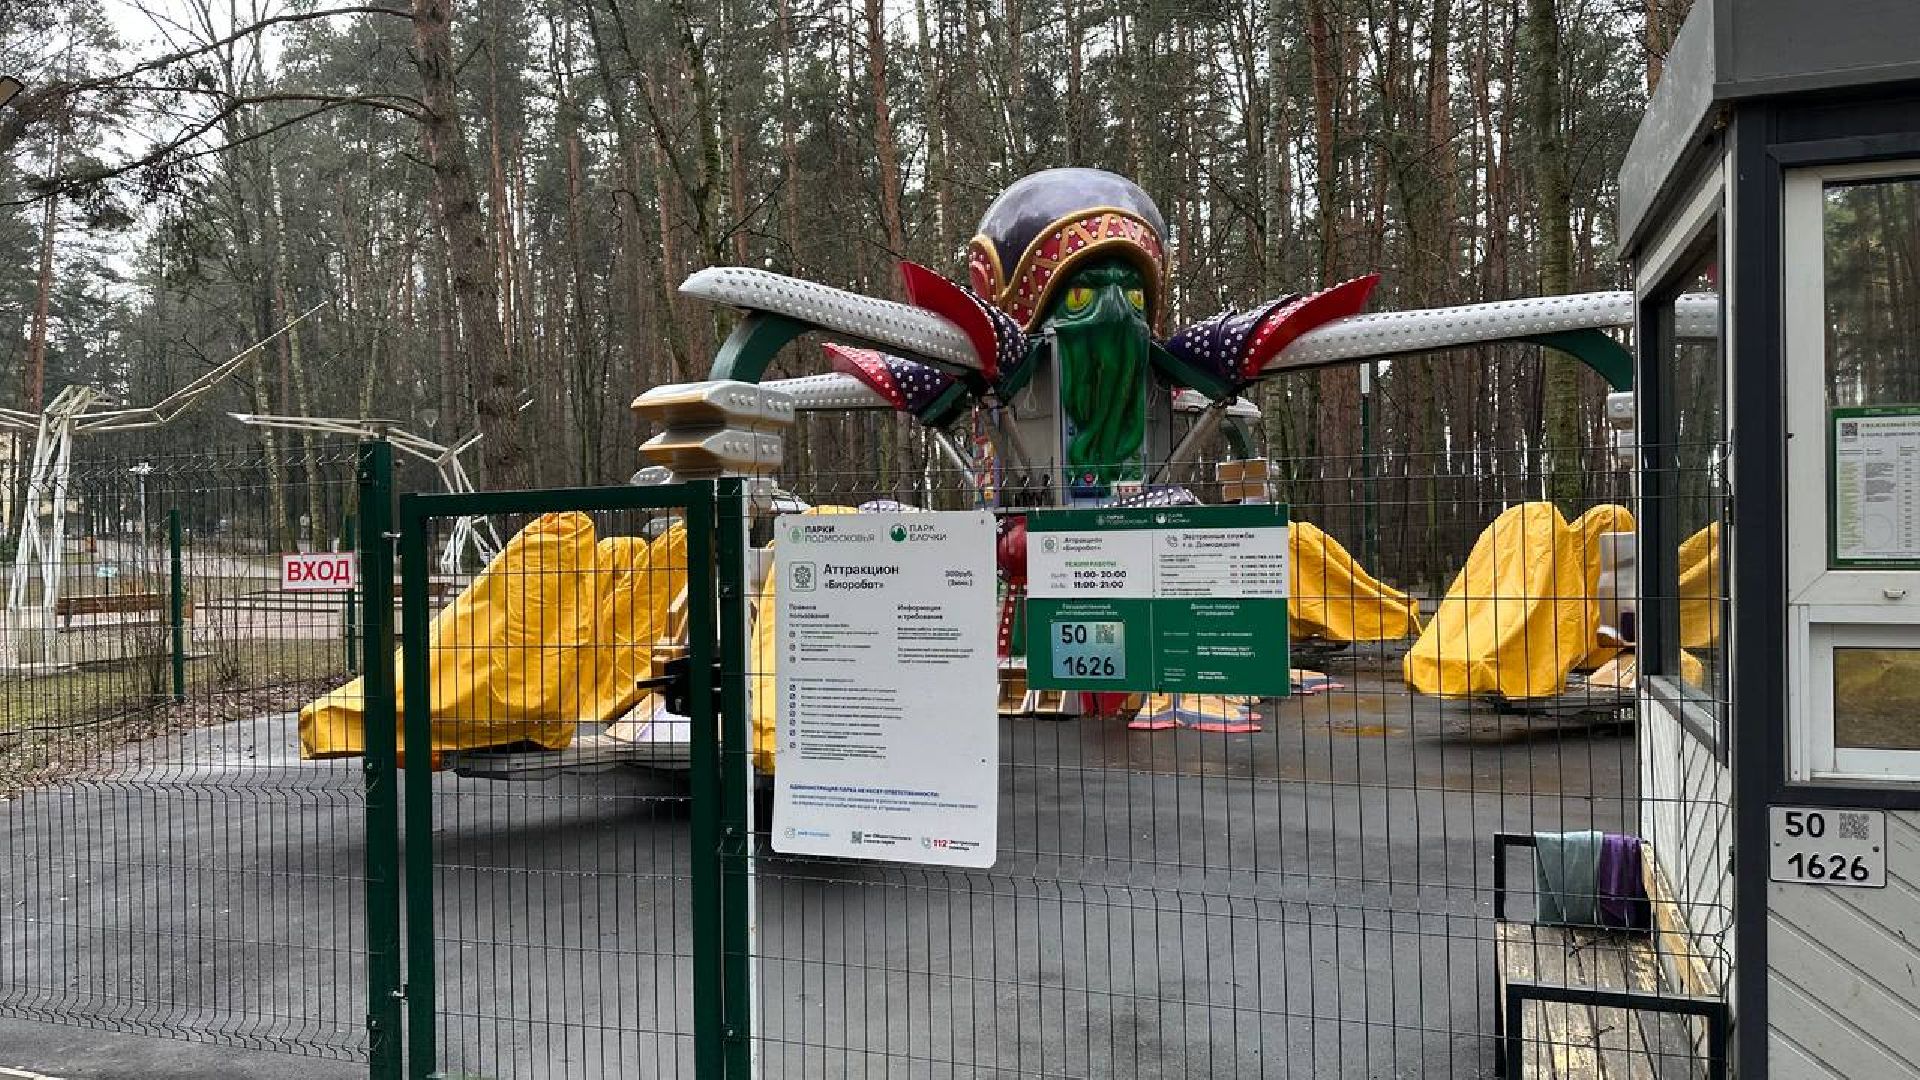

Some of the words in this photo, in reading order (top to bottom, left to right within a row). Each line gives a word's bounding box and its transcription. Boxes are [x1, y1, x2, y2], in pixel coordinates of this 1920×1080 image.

[804, 526, 835, 534] ПАРКИ
[909, 525, 935, 533] ПАРК
[804, 534, 875, 544] ПОДМОСКОВЬЯ
[287, 560, 349, 585] ВХОД
[823, 564, 899, 577] Аттракцион
[824, 580, 884, 590] «Биоробот»
[1061, 625, 1087, 643] 50
[1063, 656, 1115, 676] 1626
[1785, 811, 1825, 837] 50
[1788, 852, 1869, 880] 1626
